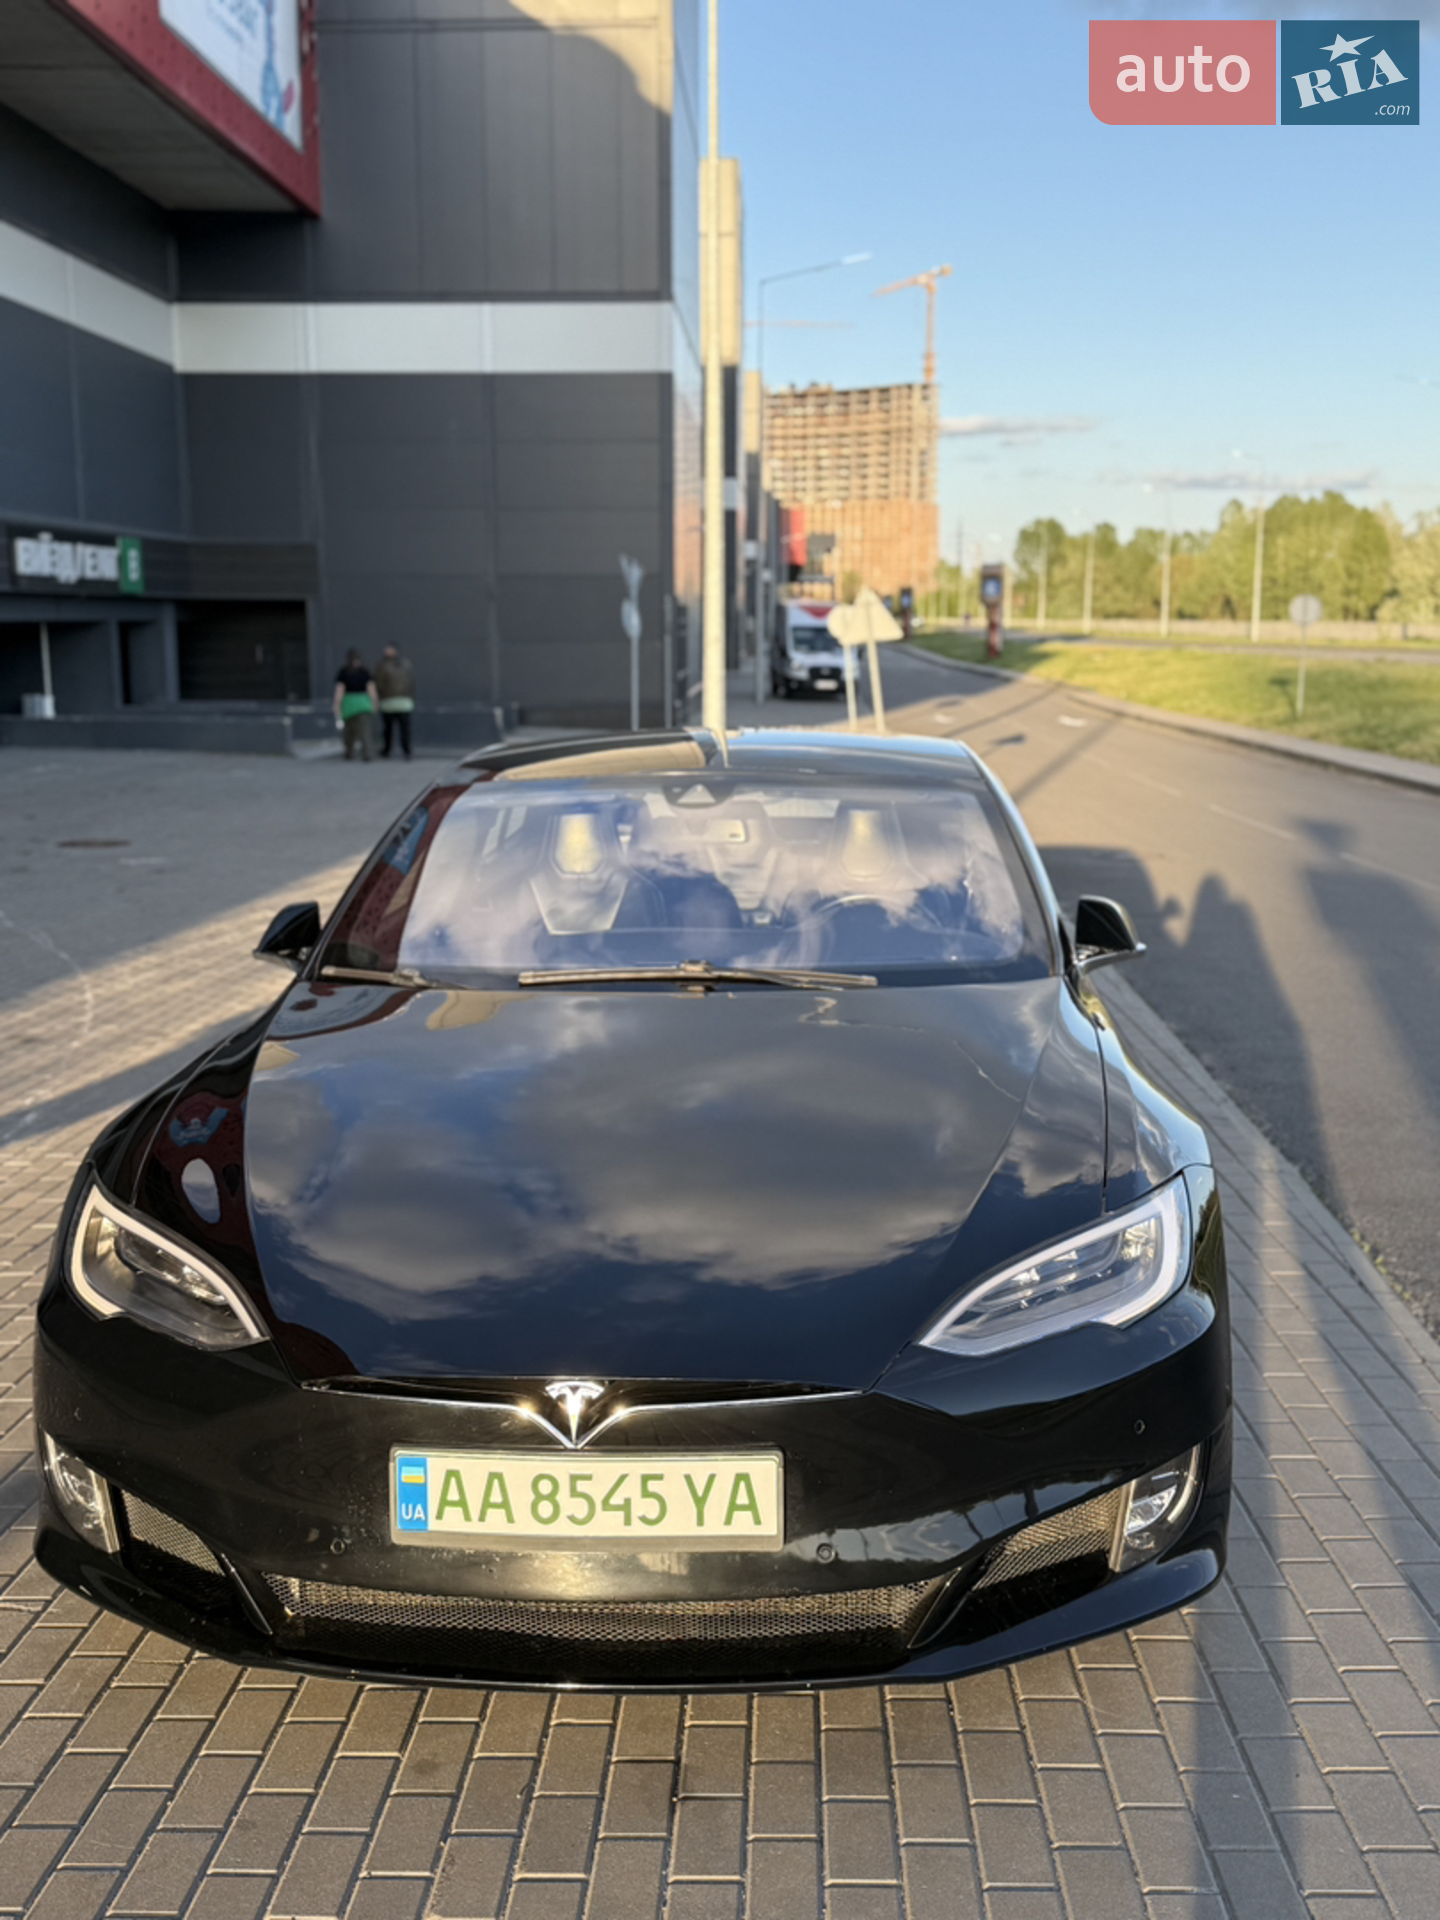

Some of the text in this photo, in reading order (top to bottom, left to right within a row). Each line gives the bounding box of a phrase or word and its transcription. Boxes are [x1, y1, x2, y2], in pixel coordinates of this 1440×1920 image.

[401, 1503, 426, 1521] UA
[435, 1468, 762, 1527] AA 8545 YA
